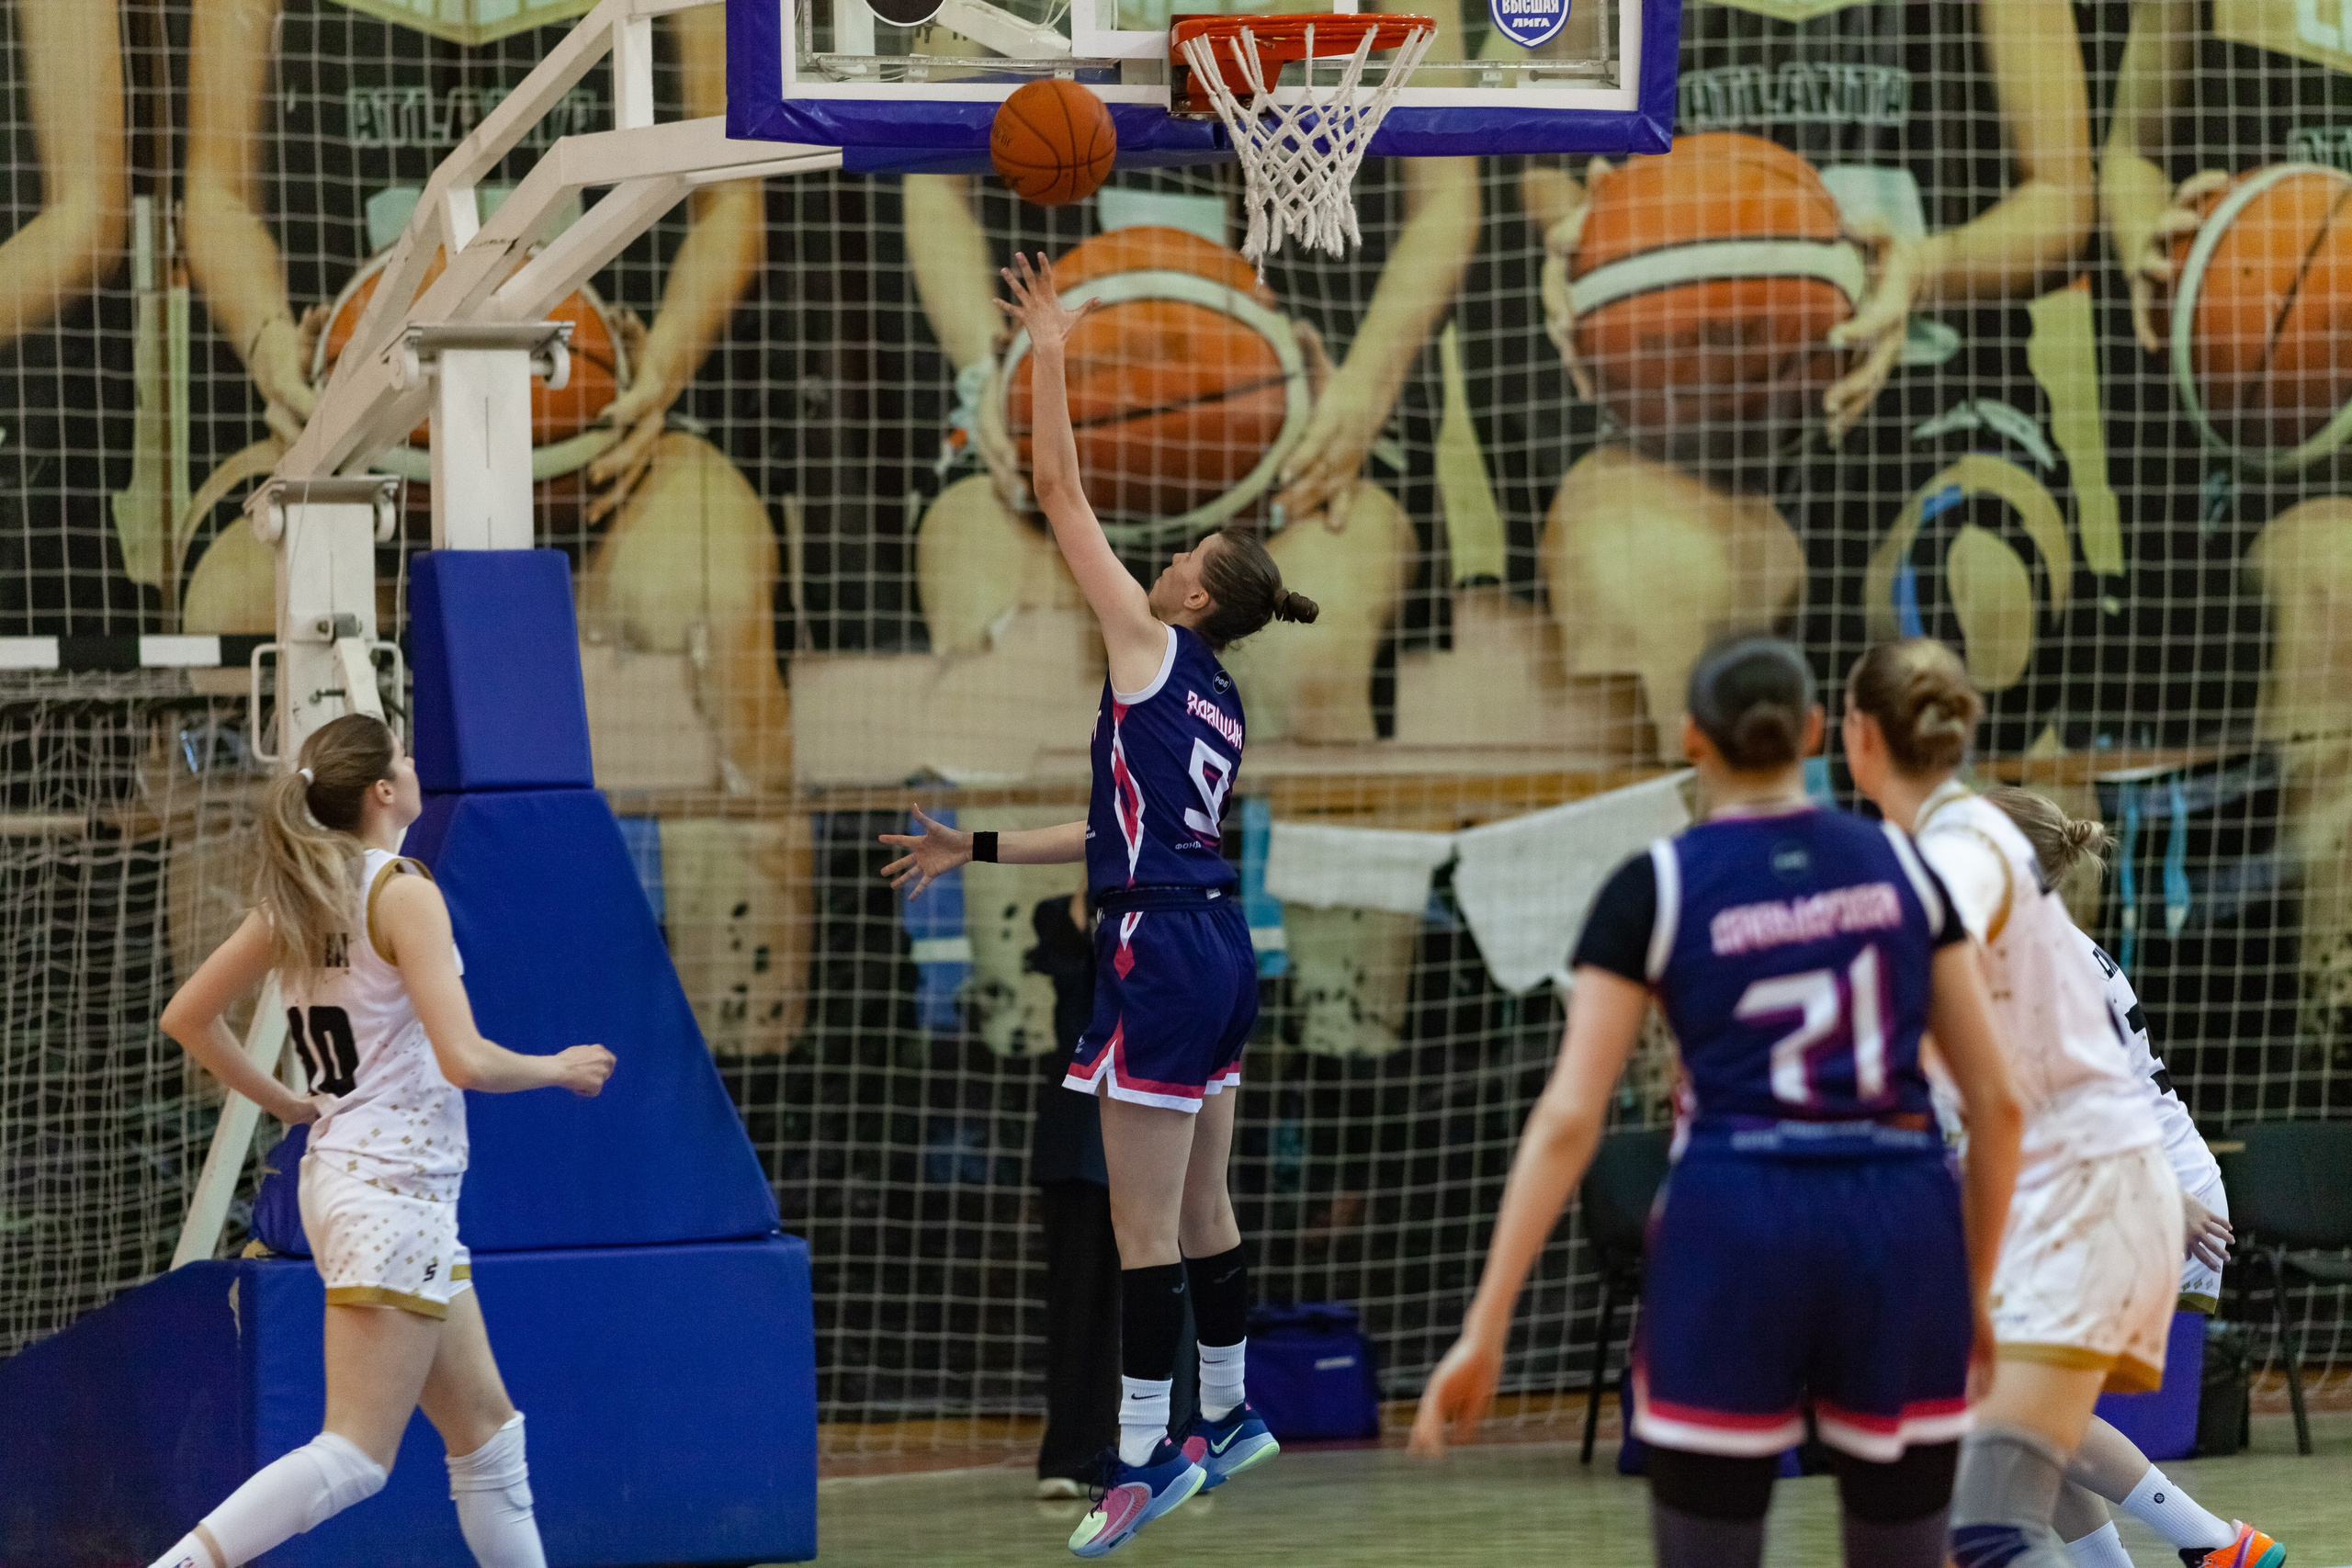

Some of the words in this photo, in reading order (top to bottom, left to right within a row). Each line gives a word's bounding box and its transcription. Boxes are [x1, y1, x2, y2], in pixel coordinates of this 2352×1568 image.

[1502, 0, 1559, 14] ВЫСШАЯ
[1511, 17, 1551, 28] ЛИГА
[1215, 675, 1229, 688] РФБ
[1184, 737, 1232, 839] 9
[1734, 942, 1885, 1105] 21
[287, 1006, 360, 1099] 10
